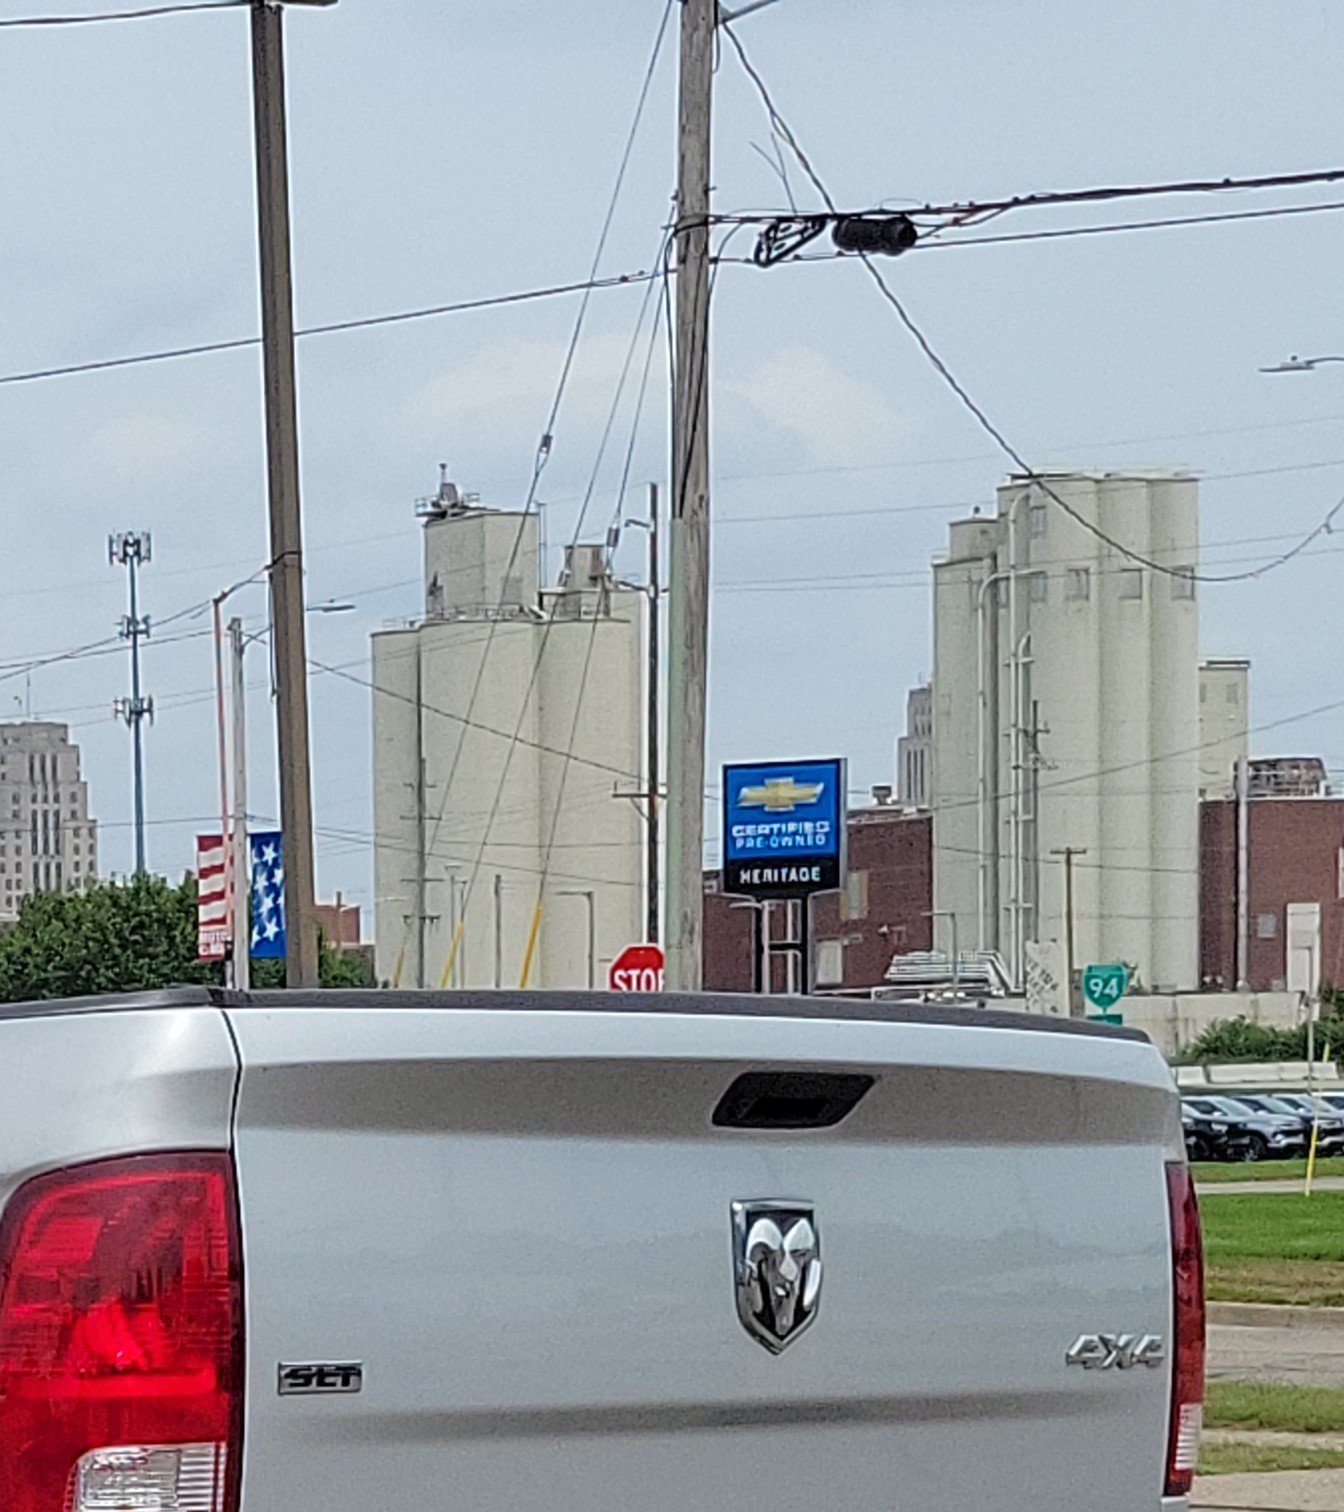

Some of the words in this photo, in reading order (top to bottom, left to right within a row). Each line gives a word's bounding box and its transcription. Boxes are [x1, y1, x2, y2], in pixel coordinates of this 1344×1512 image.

[732, 821, 831, 837] CERTIFIED
[735, 833, 827, 850] PRE-OWNED
[739, 866, 821, 884] HERITAGE
[1089, 977, 1120, 999] 94
[283, 1366, 359, 1388] SLT
